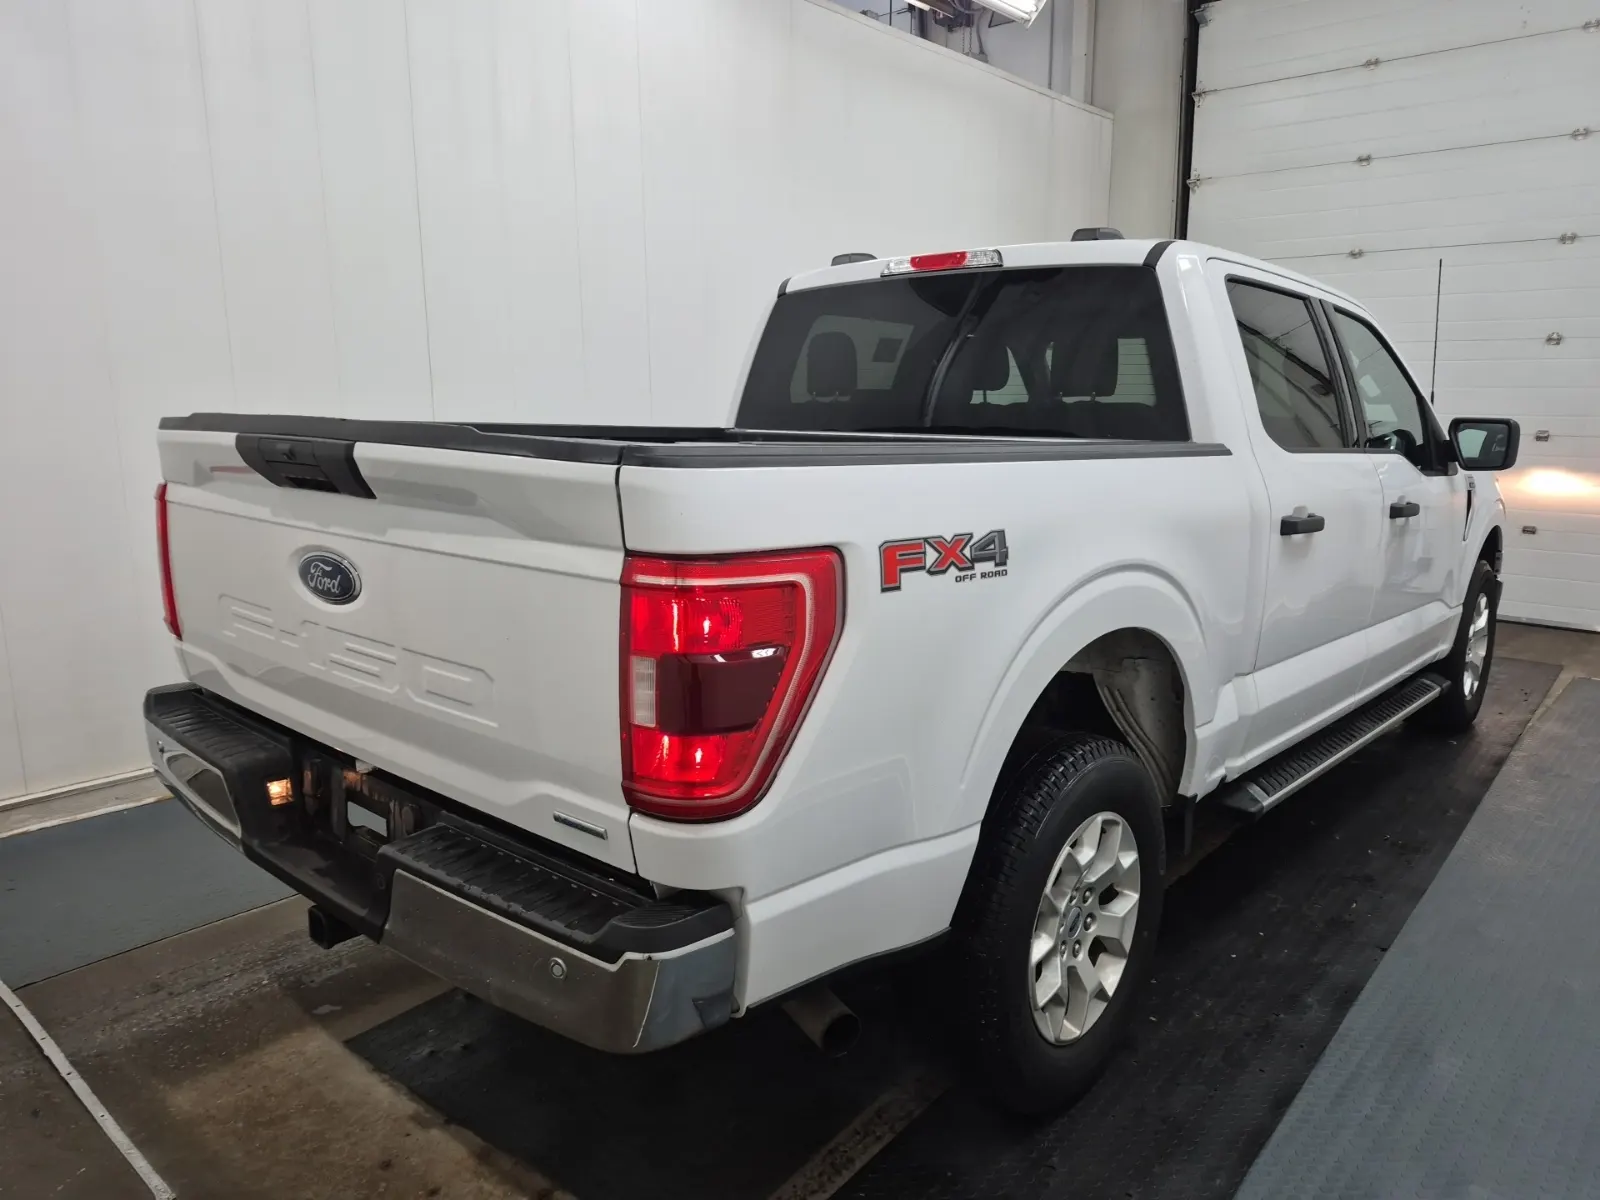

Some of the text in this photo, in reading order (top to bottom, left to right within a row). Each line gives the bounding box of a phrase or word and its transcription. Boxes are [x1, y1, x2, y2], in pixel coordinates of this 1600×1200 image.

[307, 561, 342, 594] Ford
[878, 528, 1009, 594] FX4
[954, 568, 1009, 583] OFF ROAD
